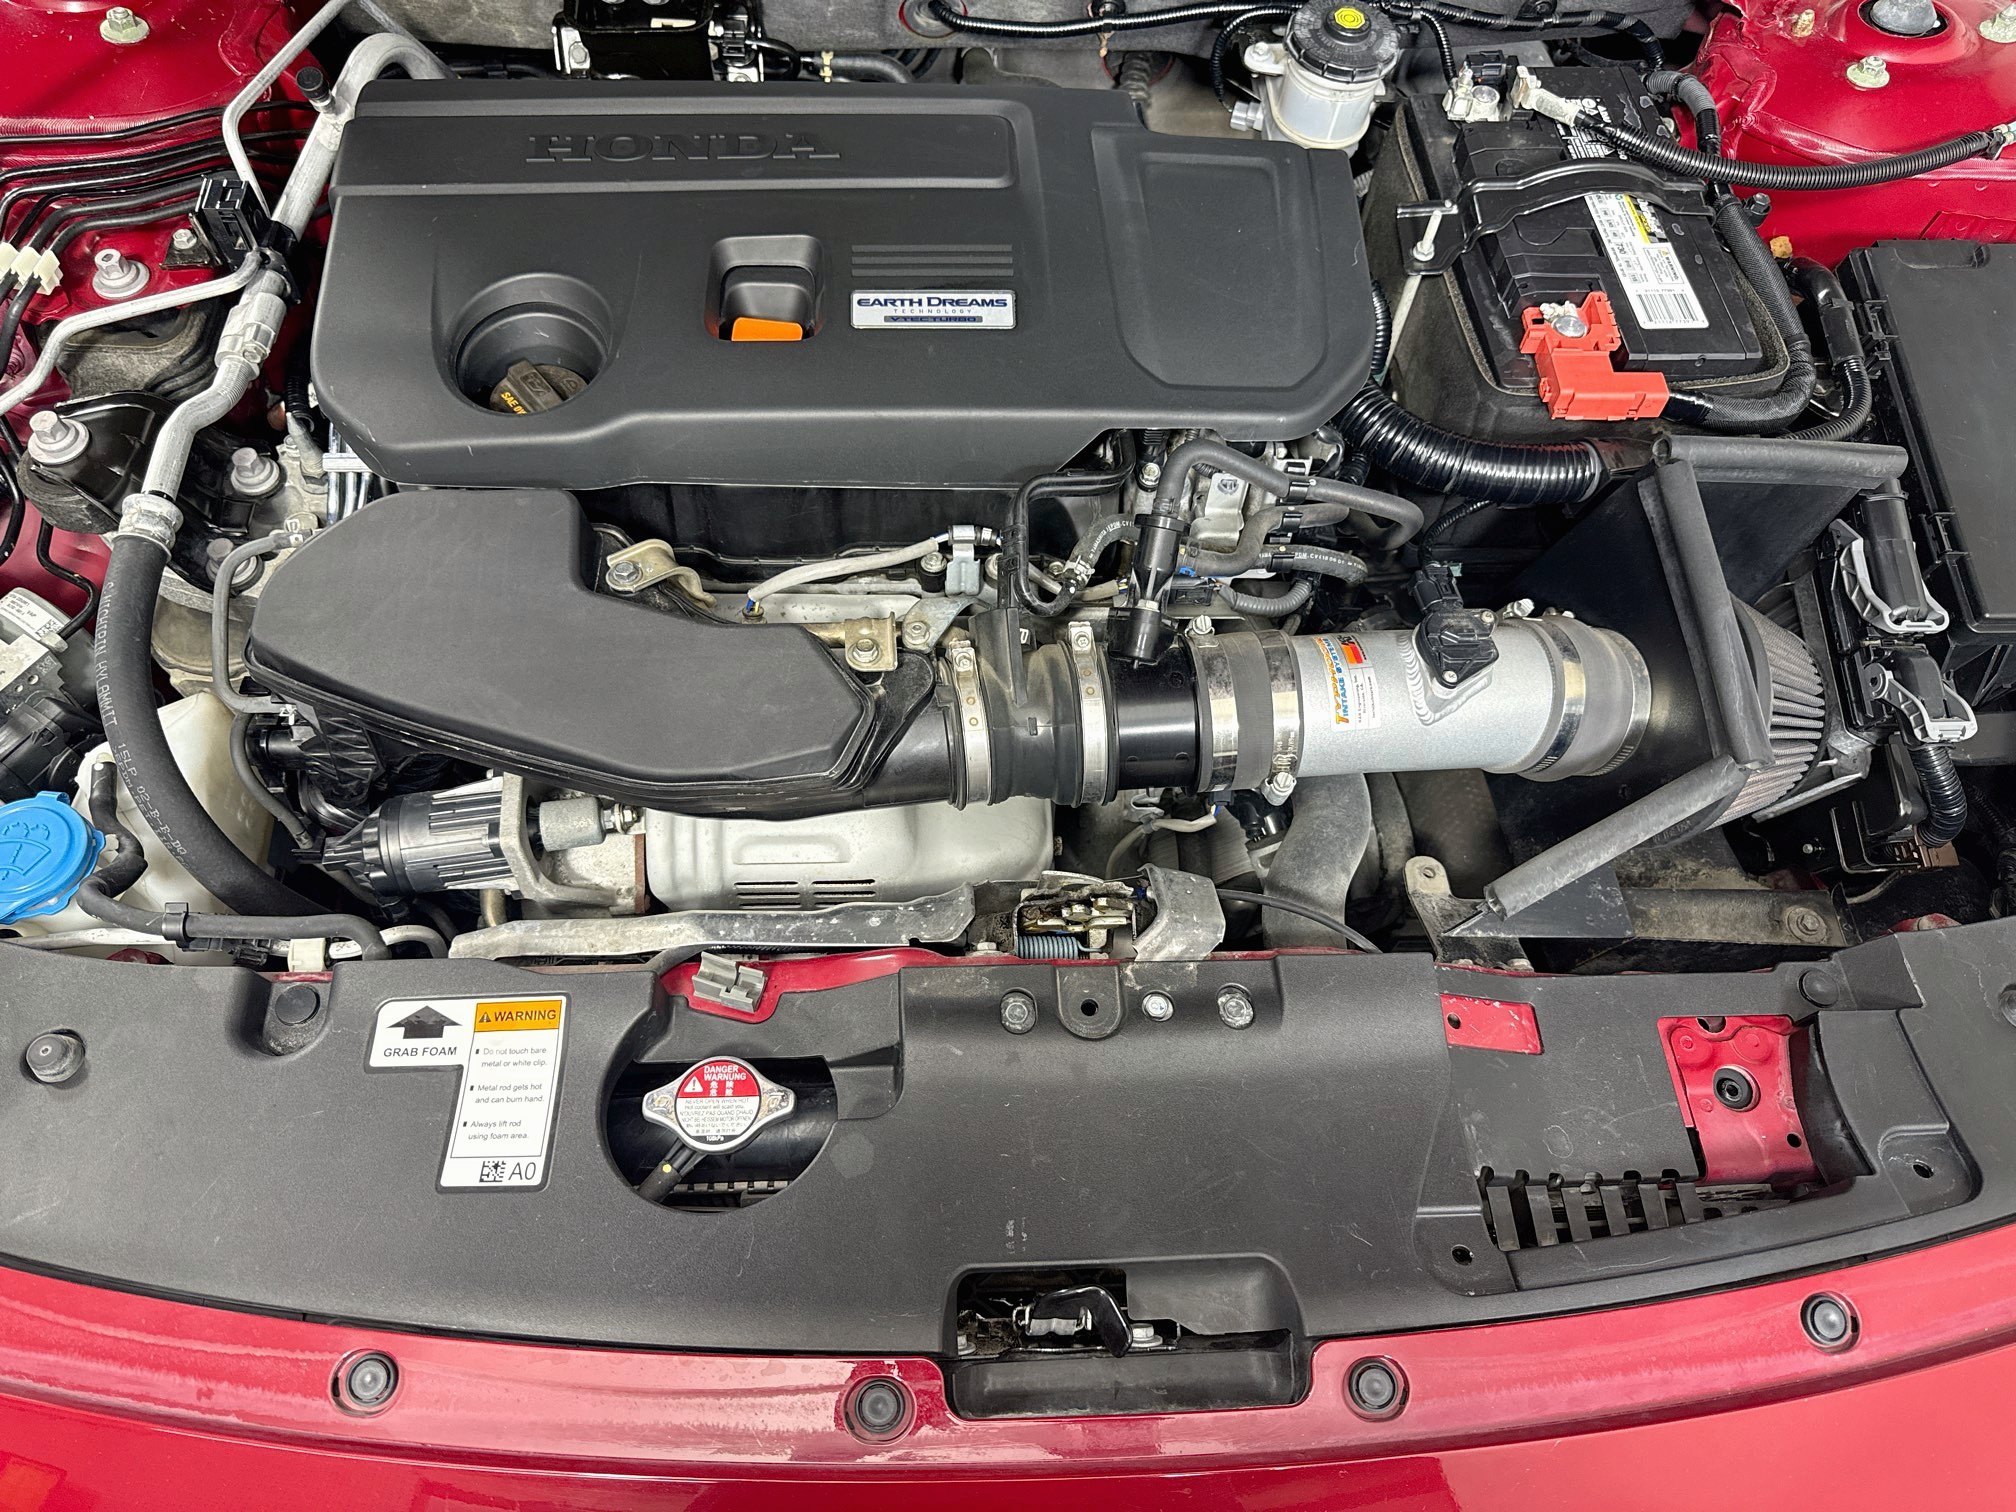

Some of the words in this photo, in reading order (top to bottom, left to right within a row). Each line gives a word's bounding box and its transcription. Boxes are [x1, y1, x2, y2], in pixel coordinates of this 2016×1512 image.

[526, 133, 840, 161] HONDA
[1615, 243, 1626, 253] 730
[857, 297, 922, 308] EARTH
[927, 296, 1008, 308] DREAMS
[501, 392, 518, 407] SAE
[94, 594, 112, 658] NICHIRIN
[1322, 638, 1342, 673] SYSTEMS
[1338, 677, 1348, 716] INTAKE
[494, 1010, 556, 1022] WARNING
[384, 1048, 418, 1057] GRAB
[422, 1046, 458, 1056] FOAM
[533, 1060, 547, 1068] clip.
[513, 1084, 528, 1093] gets
